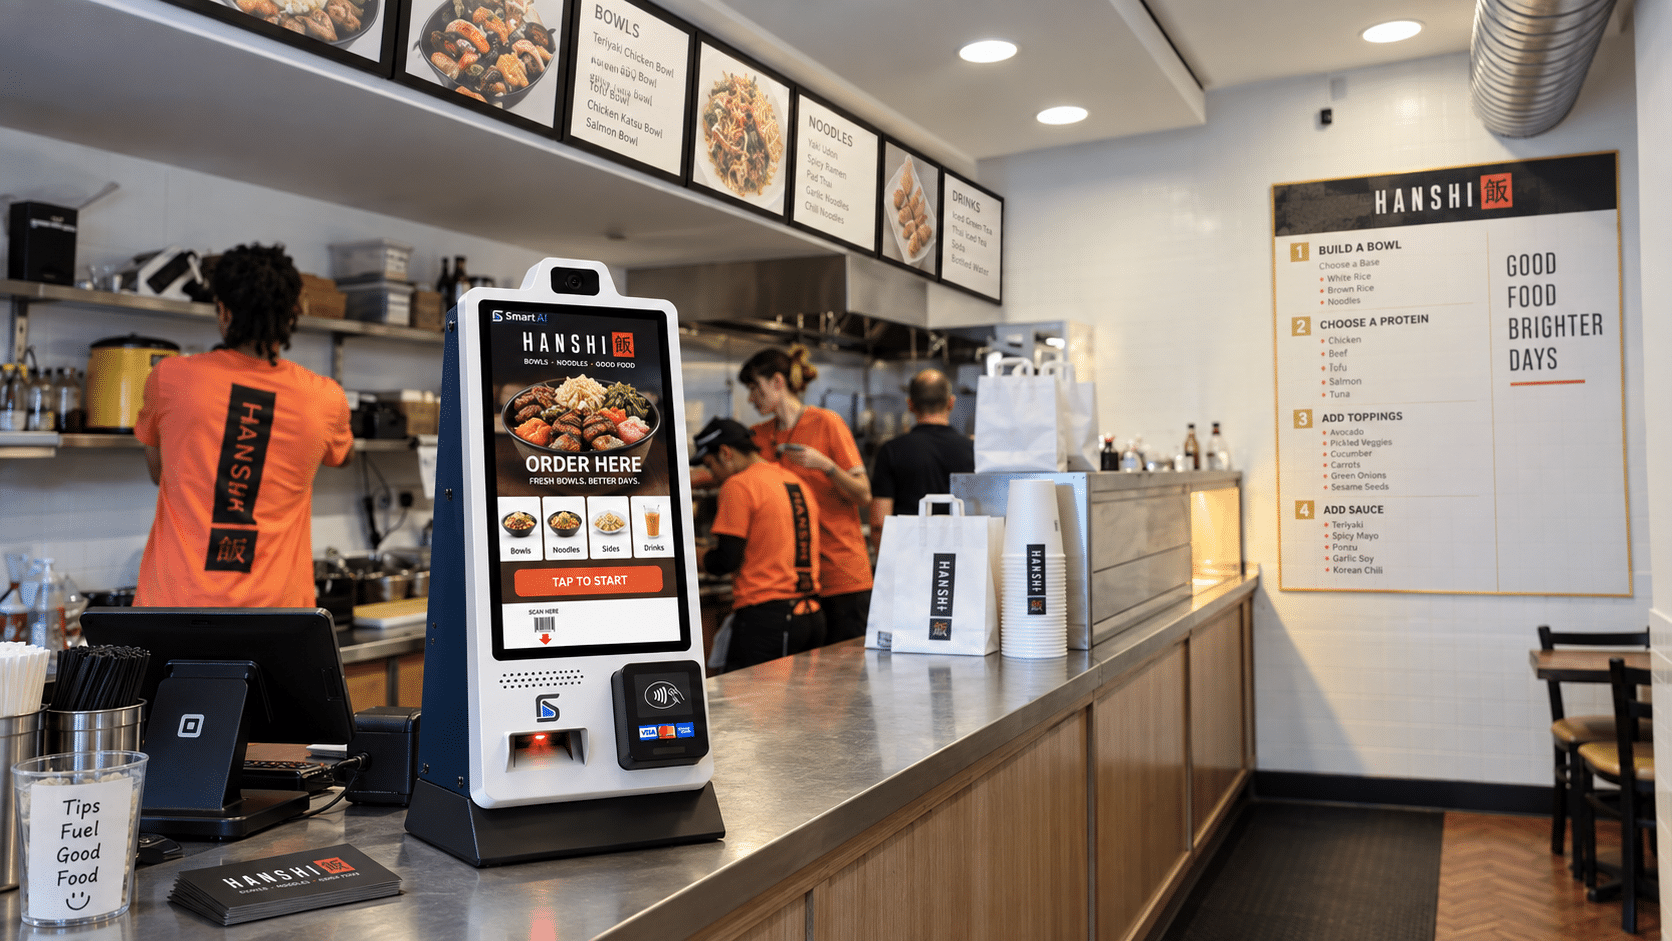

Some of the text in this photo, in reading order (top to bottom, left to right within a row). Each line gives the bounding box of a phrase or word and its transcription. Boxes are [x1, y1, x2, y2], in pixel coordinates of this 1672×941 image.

[595, 4, 640, 38] BOWLS
[593, 32, 674, 78] Teriyaki Chicken Bowl
[638, 73, 657, 88] Bowl
[587, 99, 663, 139] Chicken Katsu Bowl
[586, 118, 638, 146] Salmon Bowl
[809, 115, 853, 147] NOODLES
[807, 154, 823, 170] Spicy
[807, 170, 818, 182] Pad
[825, 193, 849, 211] Noodles
[952, 190, 980, 213] DRINKS
[1375, 179, 1508, 214] HANSHI 飯
[820, 207, 844, 224] Noodles
[1296, 241, 1402, 258] 1 BUILD A BOWL
[1319, 260, 1350, 270] Choose
[1360, 259, 1379, 267] Base
[1507, 252, 1556, 277] GOOD
[1327, 274, 1351, 282] White
[1328, 286, 1354, 294] Brown
[1508, 284, 1556, 308] FOOD
[506, 312, 535, 322] Smart
[1297, 314, 1429, 333] 2 CHOOSE A PROTEIN
[1509, 313, 1602, 340] BRIGHTER
[522, 332, 632, 354] HANSHI 飯
[1328, 336, 1361, 344] Chicken
[1329, 349, 1348, 358] Beef
[1510, 347, 1557, 371] DAYS
[1329, 363, 1347, 372] Tofu
[1329, 377, 1362, 385] Salmon
[1299, 412, 1402, 426] 3 ADD TOPPINGS
[1330, 428, 1364, 436] Avocado
[1361, 439, 1392, 447] Veggies
[1331, 450, 1372, 458] Cucumber
[526, 455, 642, 472] ORDER HERE
[1331, 461, 1360, 469] Carrots
[530, 477, 555, 485] FRESH
[557, 477, 587, 485] BOWLS.
[588, 477, 617, 485] BETTER
[1300, 504, 1384, 517] 4 ADD SAUCE
[1332, 521, 1364, 530] Teriyaki
[1332, 532, 1379, 541] Spicy Mayo
[510, 547, 531, 555] Bowls
[553, 546, 580, 554] Noodles
[602, 545, 620, 553] Sides
[1359, 555, 1374, 564] Soy
[552, 575, 628, 587] TAP TO START
[63, 799, 100, 819] Tips
[61, 820, 98, 839] Fuel
[57, 843, 100, 864] Good
[58, 866, 98, 886] Food
[222, 865, 320, 888] HANSHI
